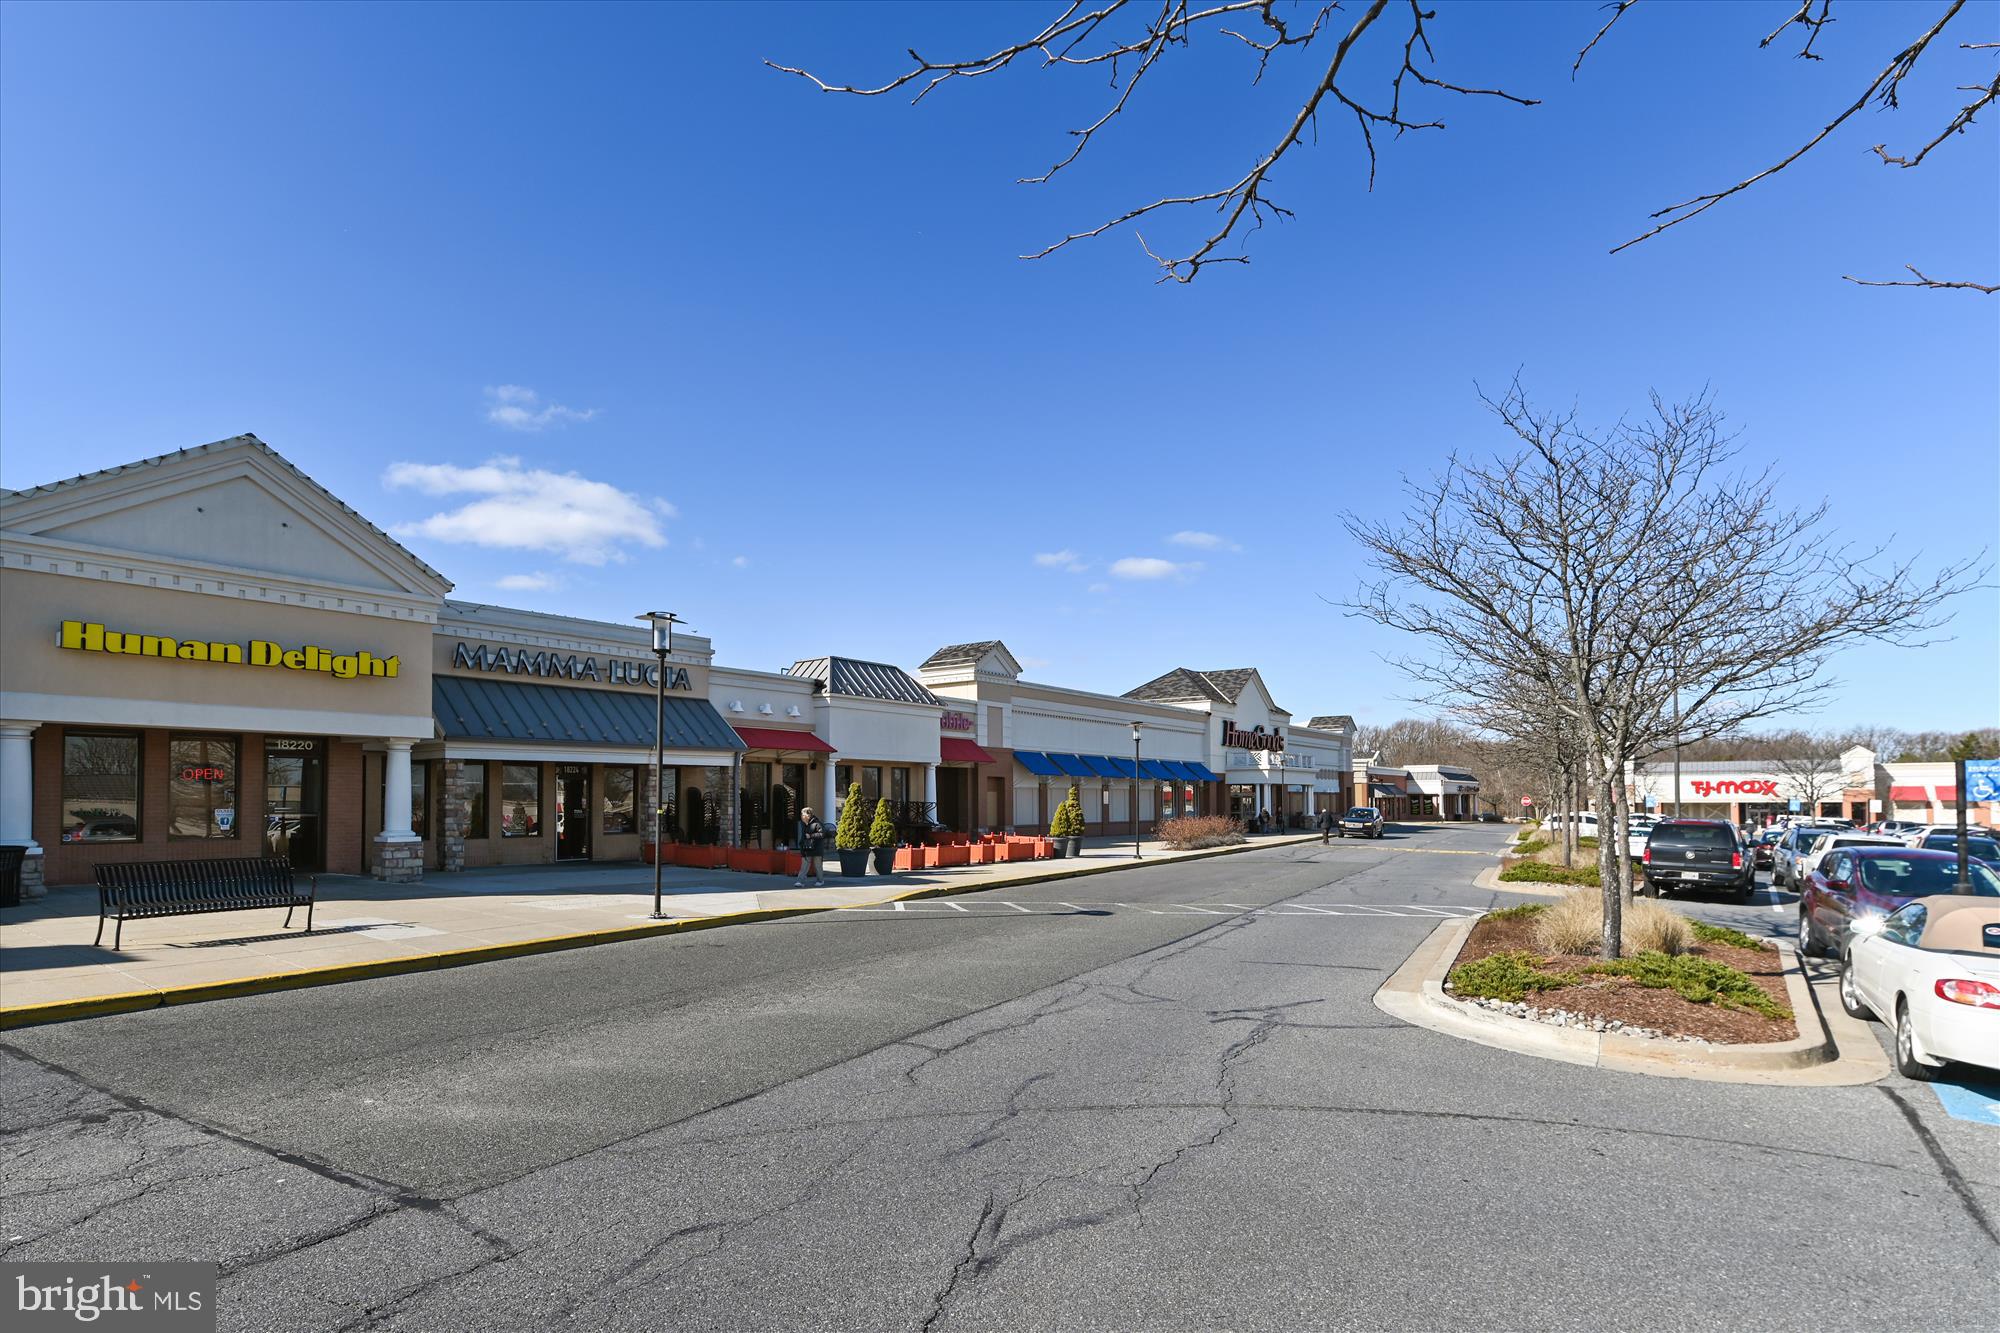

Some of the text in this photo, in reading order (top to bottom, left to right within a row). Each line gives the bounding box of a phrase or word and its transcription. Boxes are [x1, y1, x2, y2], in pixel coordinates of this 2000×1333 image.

[61, 620, 401, 679] Hunan Delight
[454, 642, 692, 691] MAMMA LUCIA
[275, 740, 313, 751] 18220
[1222, 720, 1285, 752] HomeGoods
[182, 767, 225, 780] OPEN
